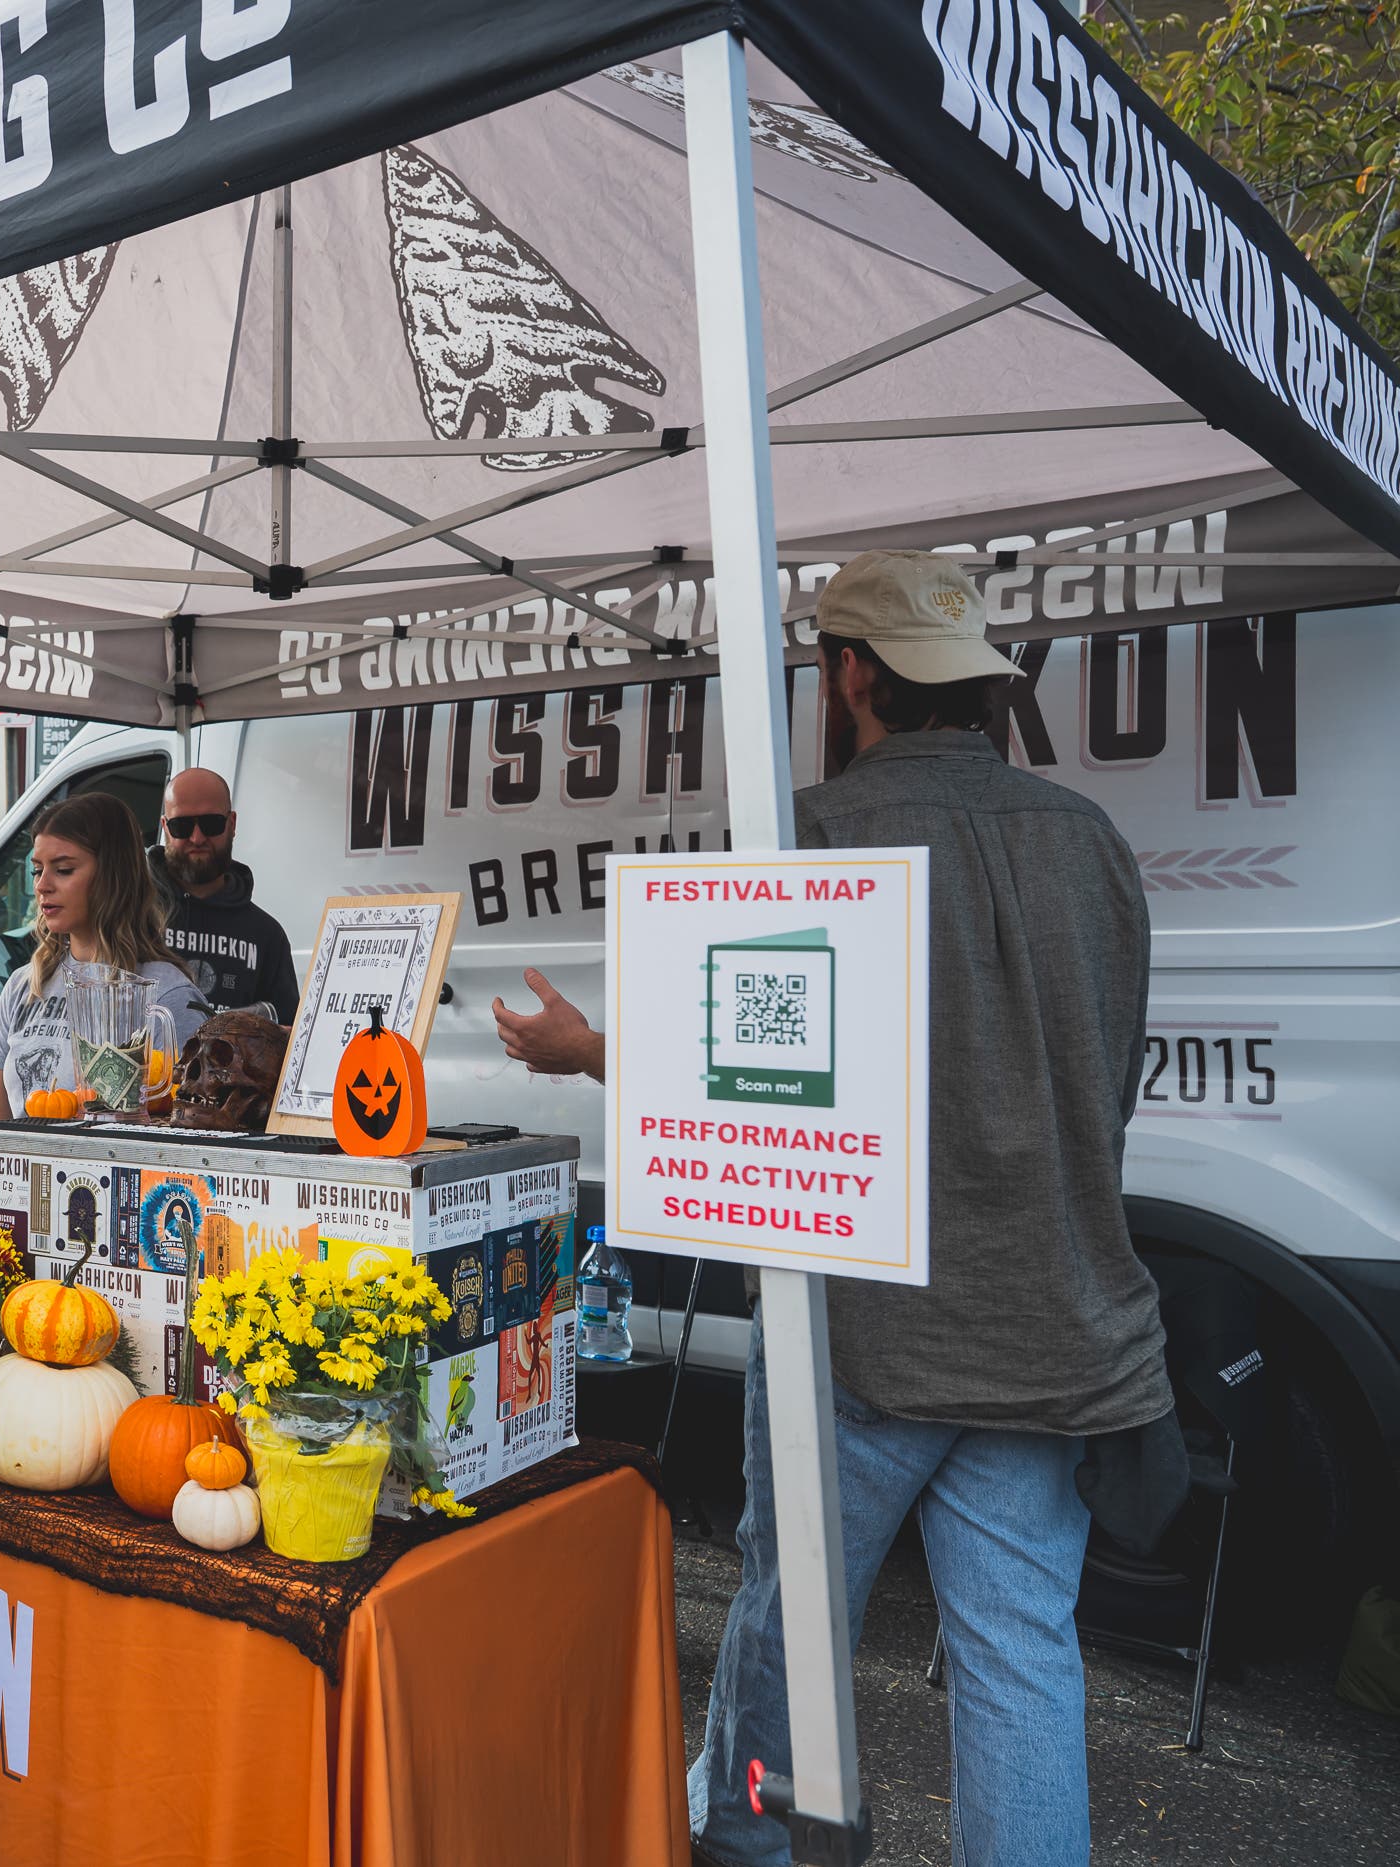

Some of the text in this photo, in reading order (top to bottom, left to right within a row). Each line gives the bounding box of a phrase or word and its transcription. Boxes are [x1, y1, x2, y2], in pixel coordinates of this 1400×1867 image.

[922, 0, 1400, 507] WISSAHICKON BREWIN
[43, 730, 70, 742] East
[645, 879, 876, 902] FESTIVAL MAP
[164, 927, 258, 971] SSAHICKON
[338, 938, 409, 959] WISSAHICKON
[347, 958, 380, 969] BREWING
[325, 992, 348, 1014] ALL
[735, 1078, 803, 1095] Scan me!
[1142, 1036, 1276, 1105] 2015
[640, 1116, 882, 1157] PERFORMANCE
[2, 1181, 14, 1192] CO
[216, 1176, 270, 1206] HICKON
[507, 1166, 561, 1201] WISSAHICKON
[646, 1156, 874, 1198] AND ACTIVITY
[297, 1182, 411, 1220] WISSAHICKON
[428, 1178, 491, 1217] WISSAHICKON
[517, 1194, 543, 1212] BREWING
[317, 1212, 389, 1231] BREWING CO
[440, 1208, 470, 1228] BREWING
[663, 1196, 855, 1238] SCHEDULES
[50, 1262, 142, 1299] WISAHICKON
[562, 1321, 575, 1440] WISSAHICKON
